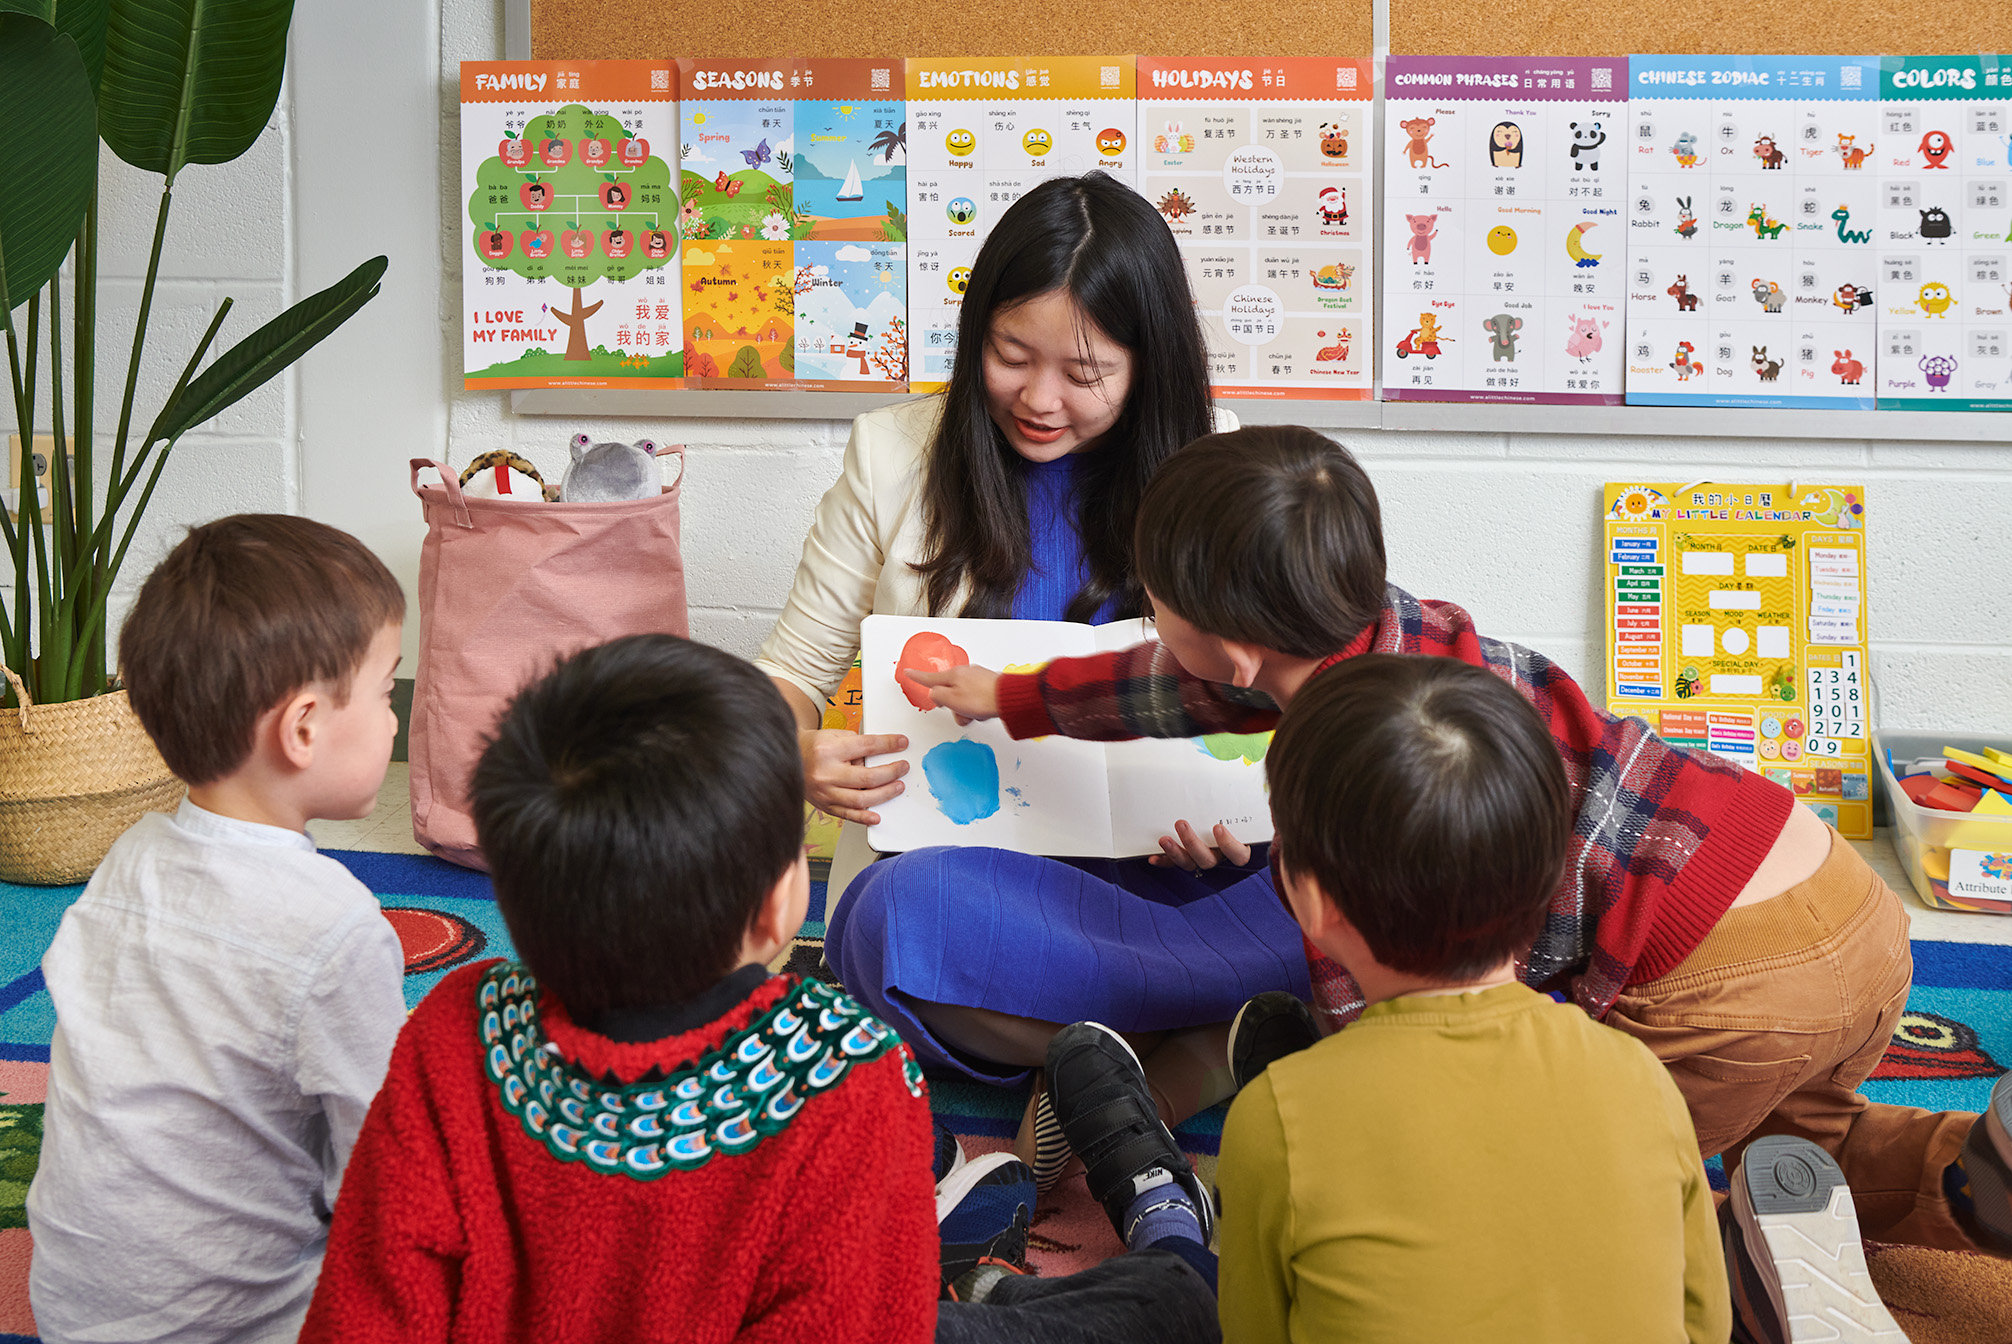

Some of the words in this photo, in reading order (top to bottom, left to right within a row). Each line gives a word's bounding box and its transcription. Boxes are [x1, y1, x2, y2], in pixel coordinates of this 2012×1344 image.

[475, 73, 547, 92] FAMILY
[693, 71, 784, 90] SEASONS
[791, 75, 813, 87] 季节
[919, 70, 1019, 90] EMOTIONS
[1026, 76, 1050, 86] 感觉
[1152, 70, 1253, 89] HOLIDAYS
[1262, 76, 1285, 86] 节日
[1395, 74, 1452, 85] COMMON
[1456, 74, 1518, 87] PHRASES
[1638, 70, 1706, 86] CHINESE
[1711, 71, 1769, 85] ZODIAC
[1777, 76, 1824, 86] 十二生肖
[1893, 69, 1976, 89] COLORS
[556, 78, 579, 89] 家庭
[1524, 79, 1575, 88] 日常用语
[1592, 110, 1610, 118] Sorry
[584, 120, 604, 129] 外公
[762, 119, 781, 127] 春天
[875, 120, 893, 128] 夏天
[918, 121, 937, 130] 高兴
[995, 122, 1014, 131] 伤心
[1071, 122, 1091, 130] 生气
[1204, 129, 1235, 138] 复活节
[1266, 130, 1302, 139] 万圣节
[1722, 126, 1733, 138] 牛
[1805, 127, 1817, 139] 虎
[699, 132, 730, 143] Spring
[811, 134, 846, 142] Summer
[1721, 147, 1734, 155] Ox
[1800, 148, 1823, 158] Tiger
[1234, 155, 1273, 163] Western
[1976, 158, 1995, 166] Blue
[949, 160, 973, 168] Happy
[1099, 160, 1122, 168] Angry
[1232, 165, 1275, 178] Holidays
[1233, 185, 1274, 194] 西方节日
[1420, 185, 1428, 193] 请
[1494, 186, 1515, 195] 谢谢
[1569, 187, 1602, 197] 对不起
[919, 193, 938, 201] 害怕
[1721, 200, 1733, 212] 龙
[1804, 202, 1816, 213] 蛇
[1203, 225, 1234, 234] 感恩节
[1713, 221, 1744, 231] Dragon
[1973, 231, 2000, 239] Green
[763, 260, 782, 269] 秋天
[874, 262, 893, 271] 冬天
[486, 277, 505, 285] 狗狗
[700, 277, 736, 286] Autumn
[812, 278, 843, 287] Winter
[1638, 272, 1650, 284] 马
[1720, 274, 1731, 285] 羊
[1413, 281, 1433, 289] 你好
[1494, 282, 1514, 291] 早安
[1574, 284, 1594, 293] 晚安
[1234, 295, 1272, 303] Chinese
[1716, 294, 1736, 302] Goat
[1795, 296, 1828, 305] Monkey
[1432, 300, 1442, 308] Bye
[636, 305, 669, 320] 我爱
[1232, 305, 1275, 318] Holidays
[1888, 307, 1916, 315] Yellow
[1976, 307, 2003, 315] Brown
[474, 312, 478, 323] I
[486, 311, 523, 323] LOVE
[1232, 325, 1274, 333] 中国节日
[473, 330, 496, 342] MY
[501, 329, 557, 342] FAMILY
[617, 330, 669, 346] 我的家
[1719, 347, 1731, 358] 狗
[1272, 366, 1291, 374] 春节
[1717, 368, 1733, 377] Dog
[1801, 369, 1814, 379] Pig
[1412, 375, 1432, 385] 再见
[1567, 380, 1599, 389] 我爱你
[1888, 380, 1915, 389] Purple
[1975, 380, 1997, 390] Gray
[1652, 509, 1671, 519] MY
[1677, 510, 1728, 520] LITTLE
[1735, 510, 1811, 521] CALENDAR
[1811, 535, 1833, 543] DAYS
[1815, 566, 1839, 574] Tuesday
[1818, 606, 1835, 614] Friday
[1812, 619, 1837, 628] Saturday
[1816, 633, 1837, 642] Sunday
[1848, 655, 1854, 666] 1
[1813, 671, 1821, 683] 2
[1831, 671, 1839, 683] 3
[1847, 672, 1856, 683] 4
[1815, 688, 1820, 699] 1
[1832, 688, 1840, 700] 5
[1849, 689, 1858, 701] 8
[1814, 705, 1823, 717] 9
[1832, 705, 1841, 717] 0
[1853, 706, 1858, 717] 1
[1815, 722, 1823, 734] 2
[1834, 722, 1842, 734] 7
[1851, 723, 1859, 735] 2
[1809, 739, 1818, 751] 0
[1827, 742, 1836, 754] 9
[1955, 882, 2007, 894] Attribute
